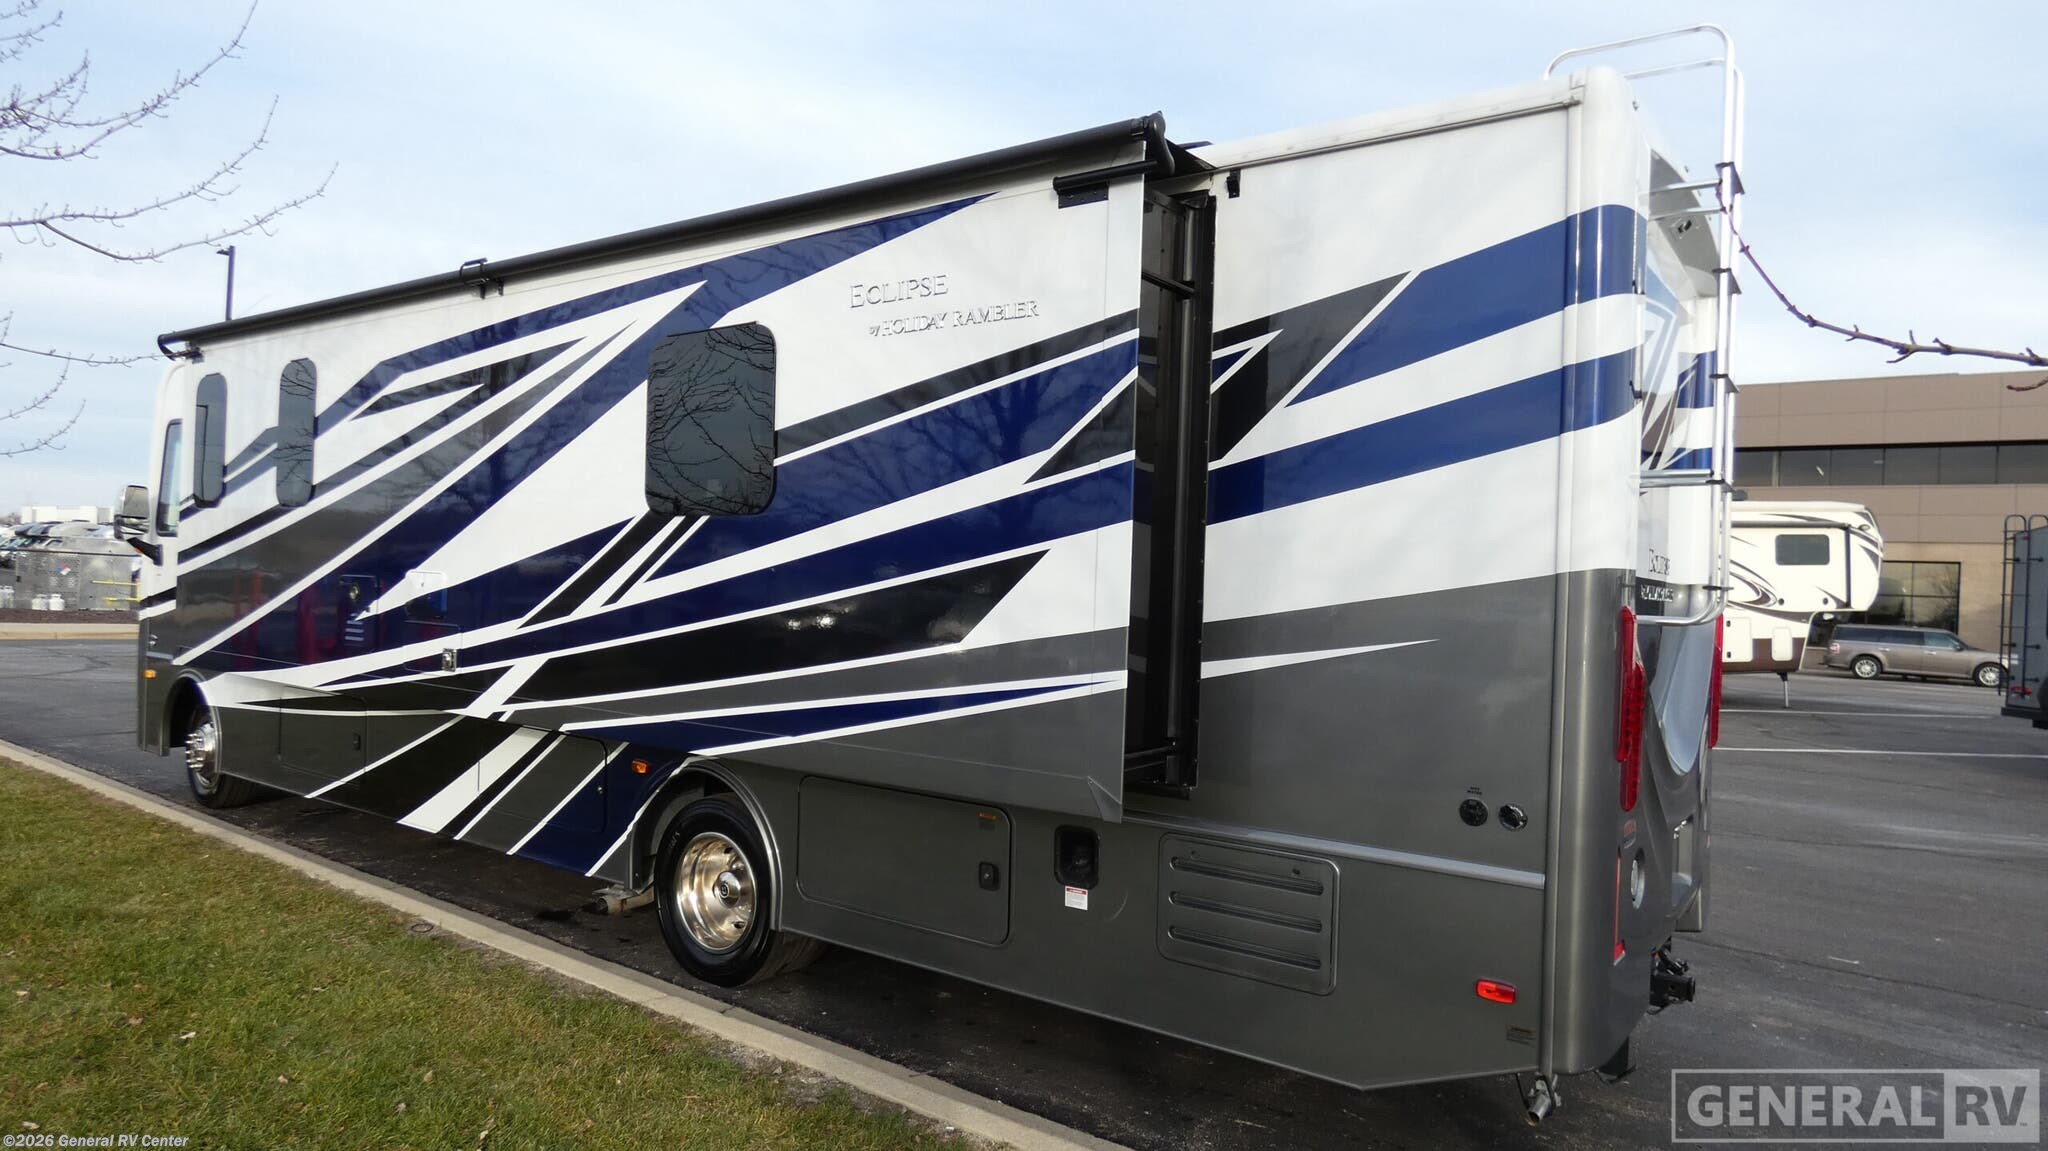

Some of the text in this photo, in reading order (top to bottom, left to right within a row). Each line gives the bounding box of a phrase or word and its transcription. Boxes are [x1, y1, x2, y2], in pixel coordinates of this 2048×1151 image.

[850, 274, 949, 309] ECLIPSE
[882, 311, 948, 337] HOLIDAY
[952, 300, 1040, 328] RAMBLER
